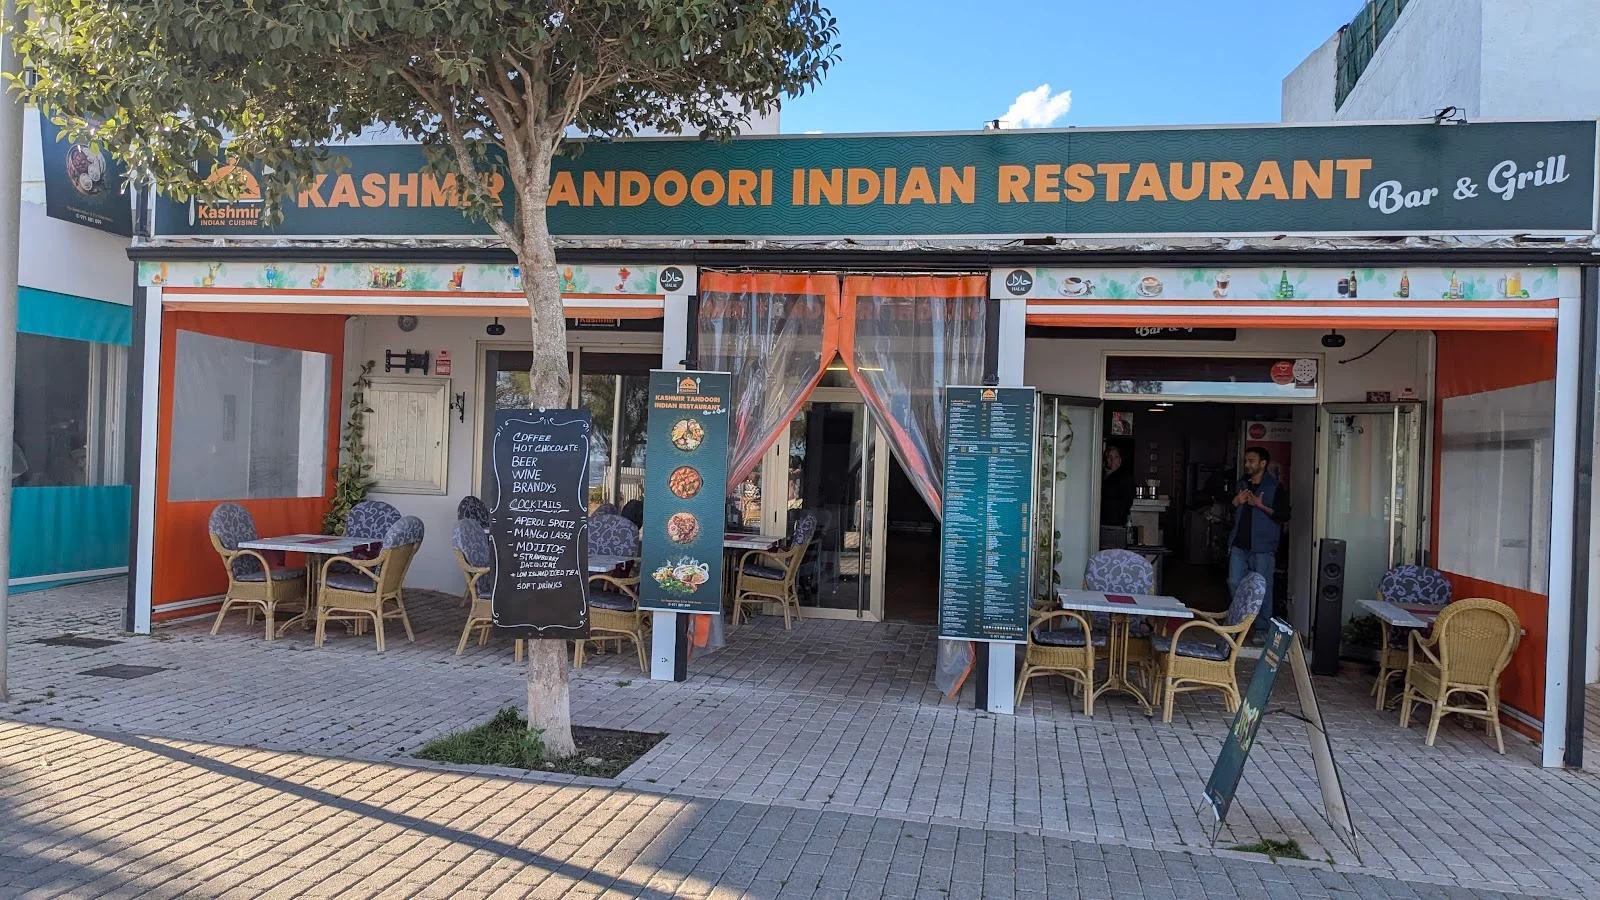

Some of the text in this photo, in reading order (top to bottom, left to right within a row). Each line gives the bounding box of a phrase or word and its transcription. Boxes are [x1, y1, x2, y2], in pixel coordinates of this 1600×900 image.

[546, 169, 773, 206] ANDOORI
[792, 166, 976, 206] INDIAN
[998, 158, 1372, 203] RESTAURANT
[1368, 154, 1570, 214] Bar & Grill
[198, 204, 261, 219] Kashmir
[660, 270, 682, 283] حلال
[1007, 273, 1031, 286] حلال
[512, 432, 552, 441] COFFEE
[512, 442, 578, 452] HOT CHOCOLATE
[512, 456, 538, 467] BEER
[512, 469, 542, 480] WINE
[512, 482, 556, 493] BRANDYS
[509, 499, 561, 509] COCKTAILS
[514, 516, 575, 529] APEROL SPRITZ
[514, 528, 572, 540] MANGO LASSI
[516, 542, 566, 554] MOJITOS
[516, 582, 536, 590] SOFT
